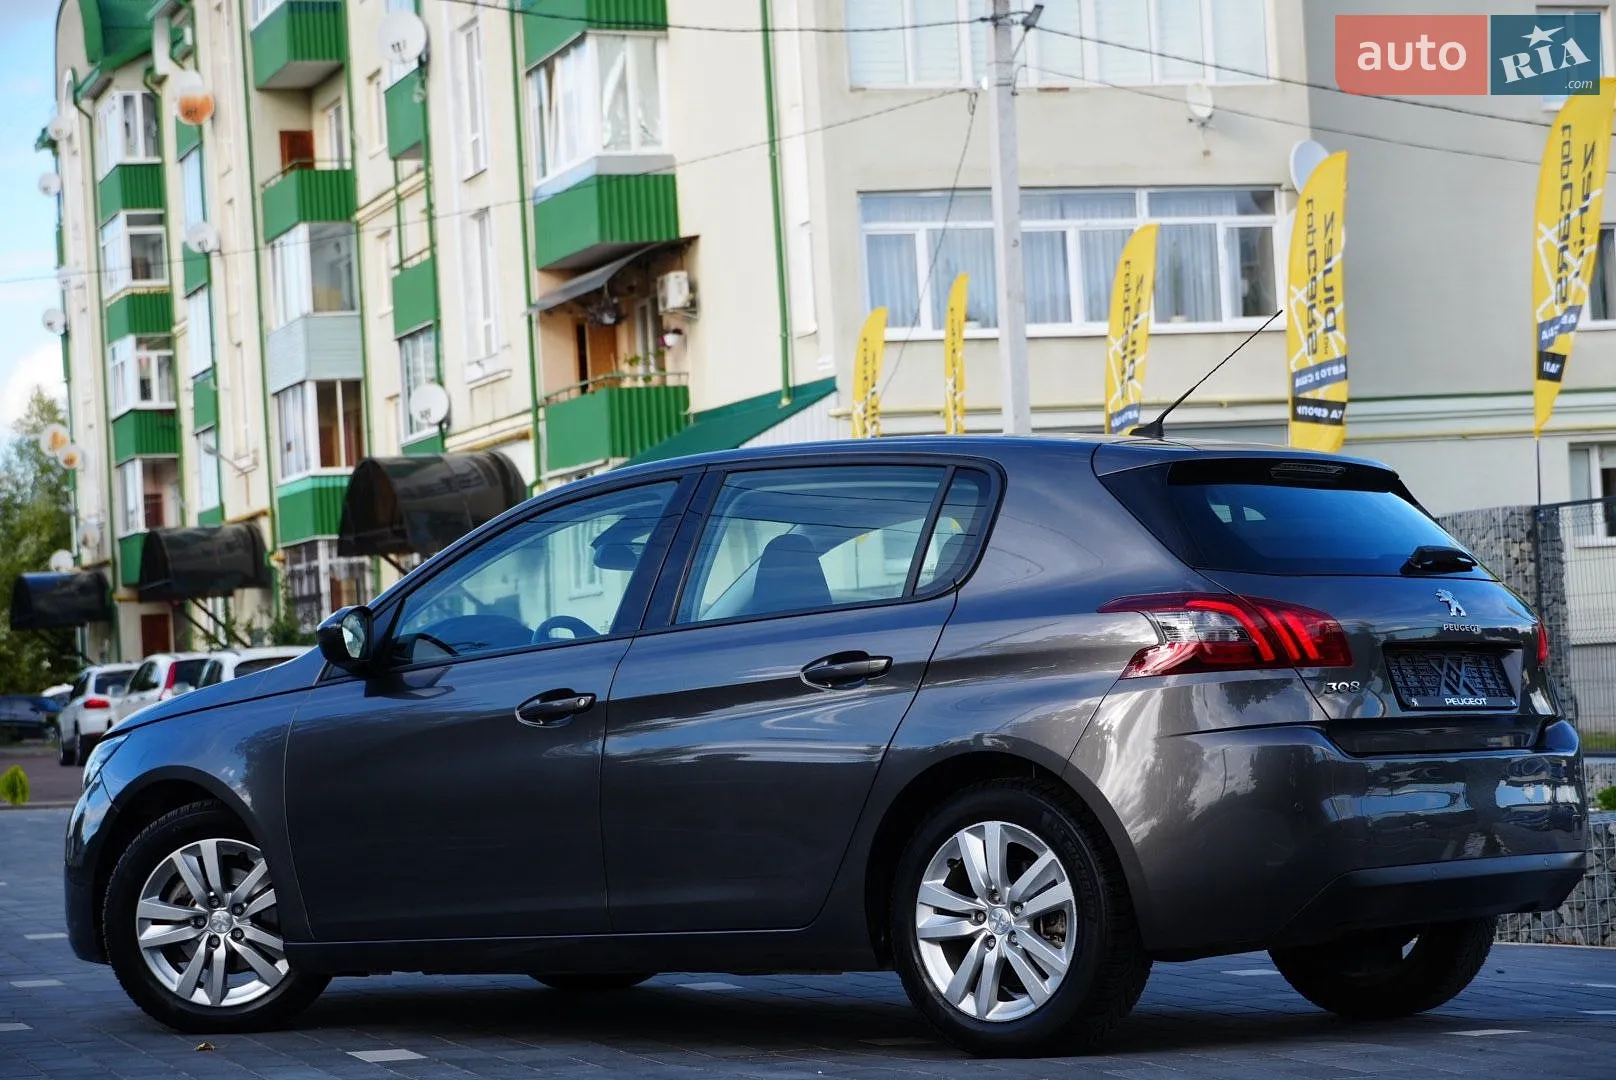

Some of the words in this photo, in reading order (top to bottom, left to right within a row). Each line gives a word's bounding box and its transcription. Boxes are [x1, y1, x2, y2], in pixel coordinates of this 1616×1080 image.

[1443, 623, 1481, 633] PEUGEOT
[1324, 680, 1361, 693] 308
[1444, 697, 1487, 706] PEUGEOT
